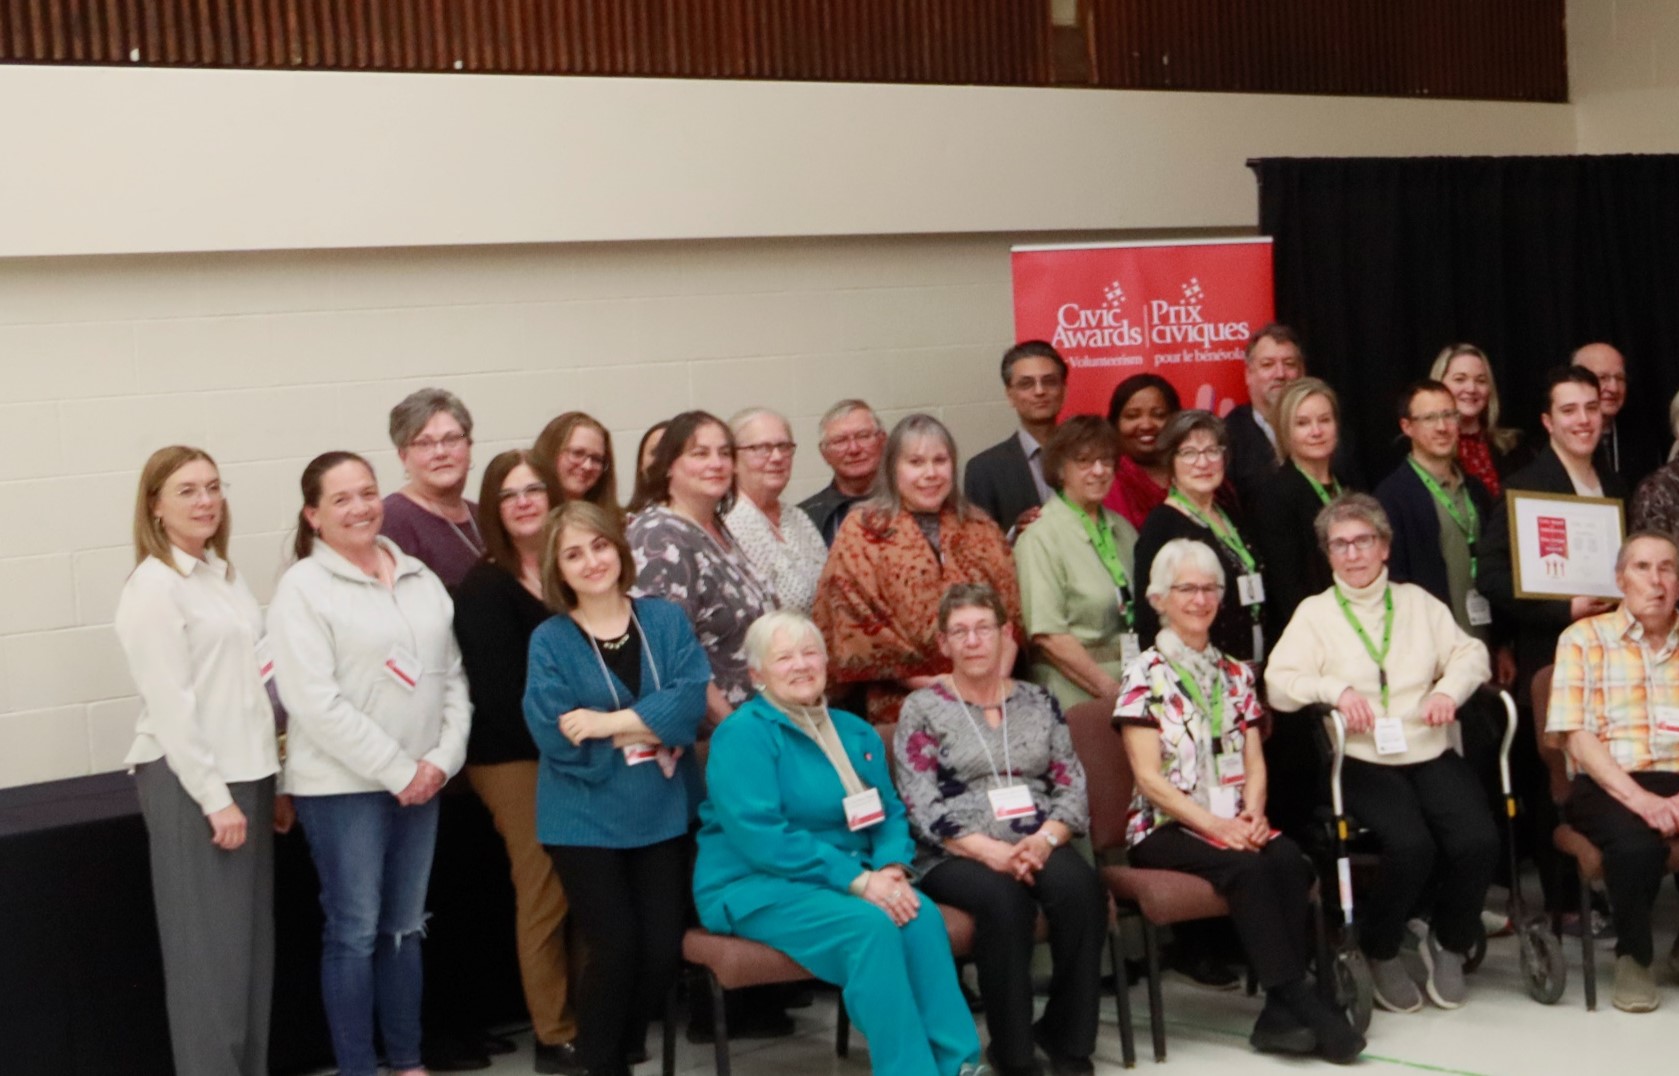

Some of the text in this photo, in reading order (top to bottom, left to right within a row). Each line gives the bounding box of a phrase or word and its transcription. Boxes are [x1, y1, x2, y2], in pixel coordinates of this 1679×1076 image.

[1057, 303, 1122, 329] Civic
[1150, 299, 1203, 325] Prix
[1051, 319, 1143, 349] Awards
[1152, 321, 1250, 349] civiques
[1069, 354, 1143, 368] Volunteerism
[1154, 347, 1246, 368] pour le bénévola
